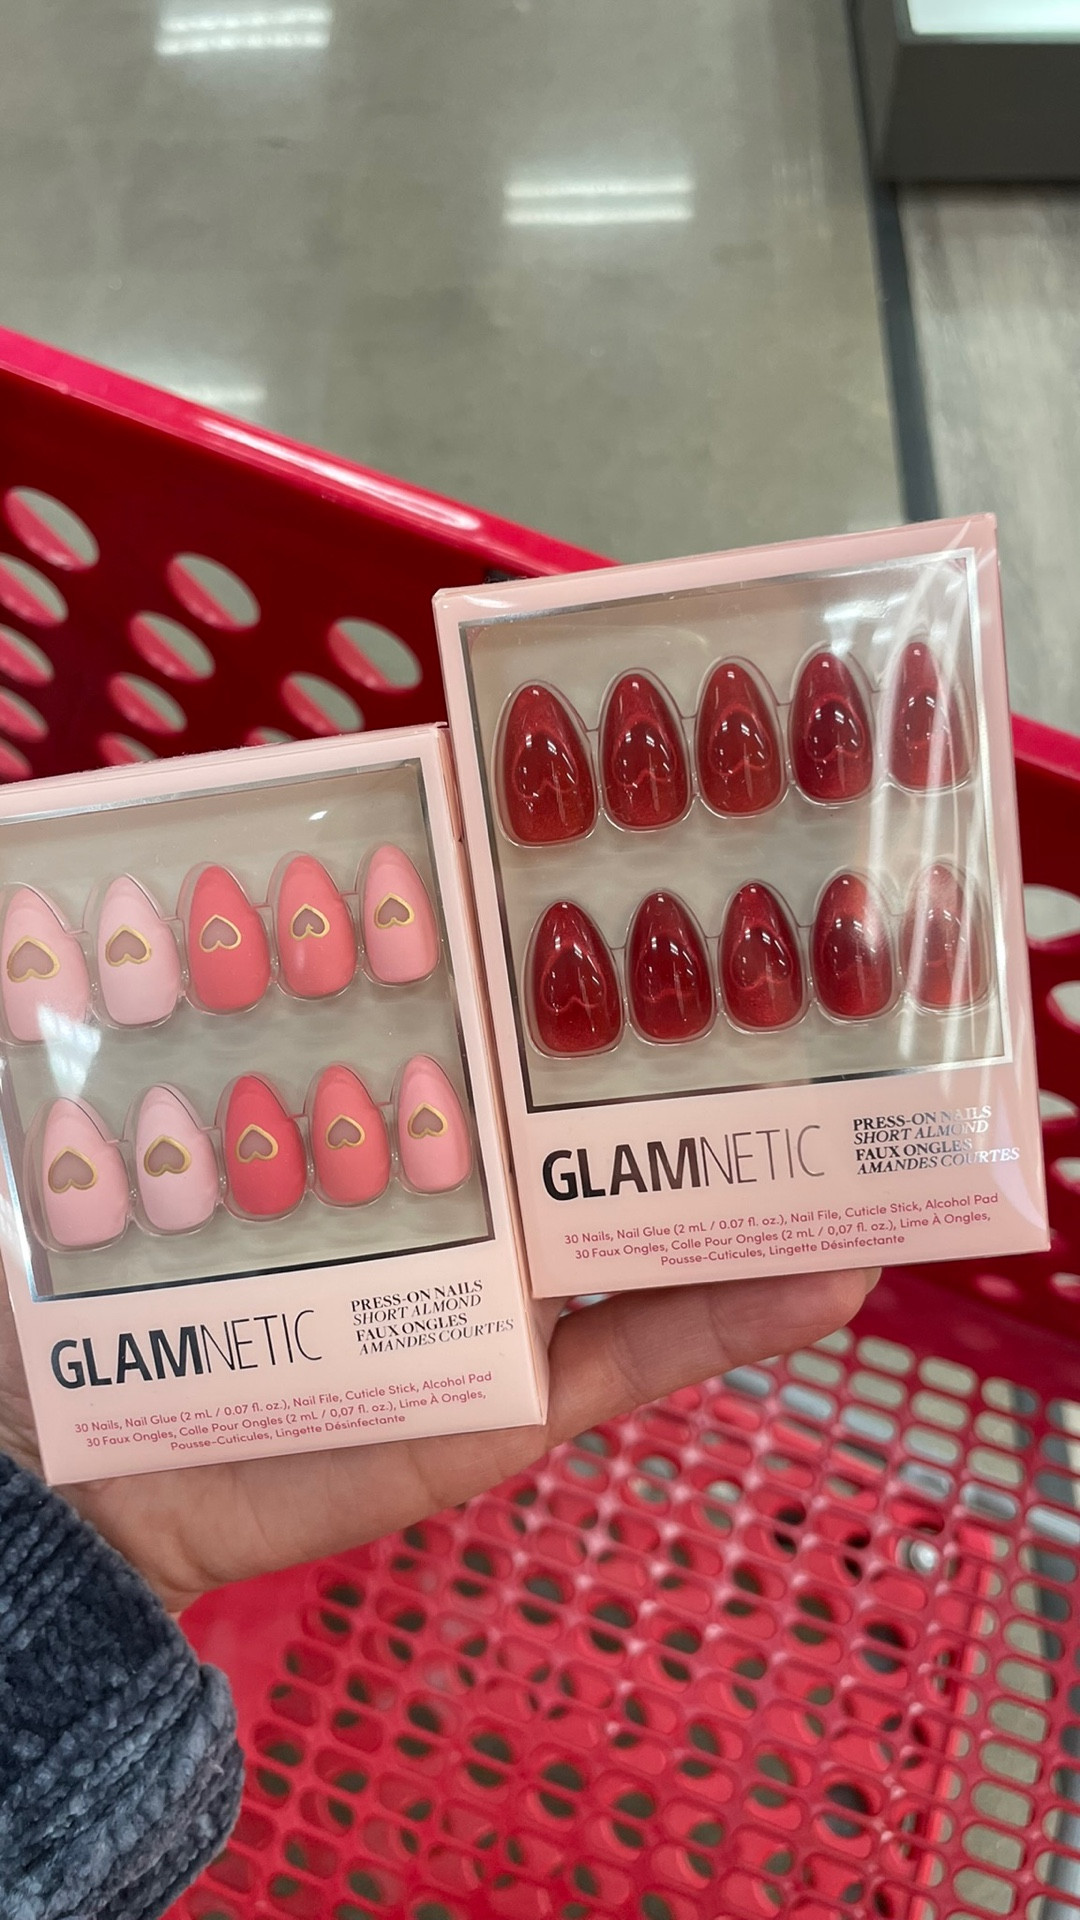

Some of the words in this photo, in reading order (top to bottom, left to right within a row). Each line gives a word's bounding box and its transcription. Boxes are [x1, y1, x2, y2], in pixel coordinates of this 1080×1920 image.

[853, 1112, 936, 1131] PRESS-ON
[940, 1105, 992, 1122] NAILS
[854, 1128, 912, 1145] SHORT
[914, 1120, 988, 1139] ALMOND
[542, 1125, 824, 1201] GLAMNETIC
[856, 1146, 900, 1161] FAUX
[903, 1138, 973, 1156] ONGLES
[857, 1156, 937, 1175] AMANDES
[941, 1147, 1020, 1167] COURTES
[565, 1234, 578, 1244] 30
[582, 1231, 613, 1242] Nails,
[617, 1228, 639, 1239] Nail
[643, 1226, 670, 1236] Glue
[674, 1224, 685, 1236] (2
[689, 1222, 706, 1232] mL
[710, 1221, 715, 1230] /
[719, 1219, 743, 1230] 0.07
[748, 1217, 758, 1226] fl.
[762, 1215, 787, 1226] oz.),
[791, 1212, 814, 1222] Nail
[818, 1210, 841, 1220] File,
[846, 1205, 886, 1217] Cuticle
[890, 1202, 922, 1213] Stick,
[926, 1196, 970, 1209] Alcohol
[974, 1193, 998, 1204] Pad
[576, 1250, 589, 1259] 30
[592, 1248, 620, 1257] Faux
[623, 1243, 668, 1255] Ongles,
[671, 1239, 701, 1250] Colle
[705, 1237, 732, 1246] Pour
[736, 1232, 778, 1245] Ongles
[782, 1230, 792, 1241] (2
[797, 1228, 814, 1238] mL
[818, 1227, 823, 1236] /
[828, 1224, 852, 1236] 0,07
[857, 1222, 867, 1232] fl.
[871, 1220, 896, 1231] oz.),
[900, 1219, 928, 1228] Lime
[932, 1213, 940, 1225] À
[944, 1212, 990, 1224] Ongles,
[660, 1248, 766, 1266] Pousse-Cuticules,
[769, 1243, 817, 1256] Lingette
[821, 1235, 905, 1251] Désinfectante
[351, 1289, 430, 1312] PRESS-ON
[434, 1279, 483, 1299] NAILS
[353, 1306, 408, 1326] SHORT
[411, 1294, 482, 1317] ALMOND
[357, 1325, 399, 1342] FAUX
[402, 1313, 468, 1334] ONGLES
[359, 1332, 436, 1356] AMANDES
[439, 1319, 514, 1342] COURTES
[51, 1310, 322, 1389] GLAMNETIC
[75, 1424, 88, 1432] 30
[92, 1420, 122, 1431] Nails,
[125, 1416, 148, 1428] Nail
[150, 1415, 177, 1424] Glue
[180, 1411, 190, 1422] (2
[195, 1410, 212, 1419] mL
[216, 1408, 220, 1416] /
[224, 1405, 248, 1416] 0.07
[252, 1402, 263, 1412] fl.
[266, 1399, 290, 1410] oz.),
[293, 1396, 315, 1407] Nail
[319, 1393, 342, 1404] File,
[346, 1388, 385, 1400] Cuticle
[389, 1383, 419, 1395] Stick,
[422, 1376, 465, 1390] Alcohol
[469, 1371, 492, 1383] Pad
[87, 1438, 100, 1447] 30
[103, 1436, 130, 1445] Faux
[133, 1430, 176, 1442] Ongles,
[180, 1425, 208, 1436] Colle
[212, 1423, 238, 1432] Pour
[242, 1417, 282, 1428] Ongles
[286, 1414, 297, 1424] (2
[301, 1412, 318, 1421] mL
[322, 1410, 326, 1418] /
[330, 1406, 354, 1418] 0,07
[358, 1404, 368, 1413] fl.
[372, 1401, 396, 1412] oz.),
[400, 1399, 427, 1408] Lime
[430, 1393, 438, 1404] À
[442, 1390, 486, 1402] Ongles,
[171, 1432, 273, 1451] Pousse-Cuticules,
[276, 1425, 322, 1438] Lingette
[325, 1415, 406, 1432] Désinfectante
